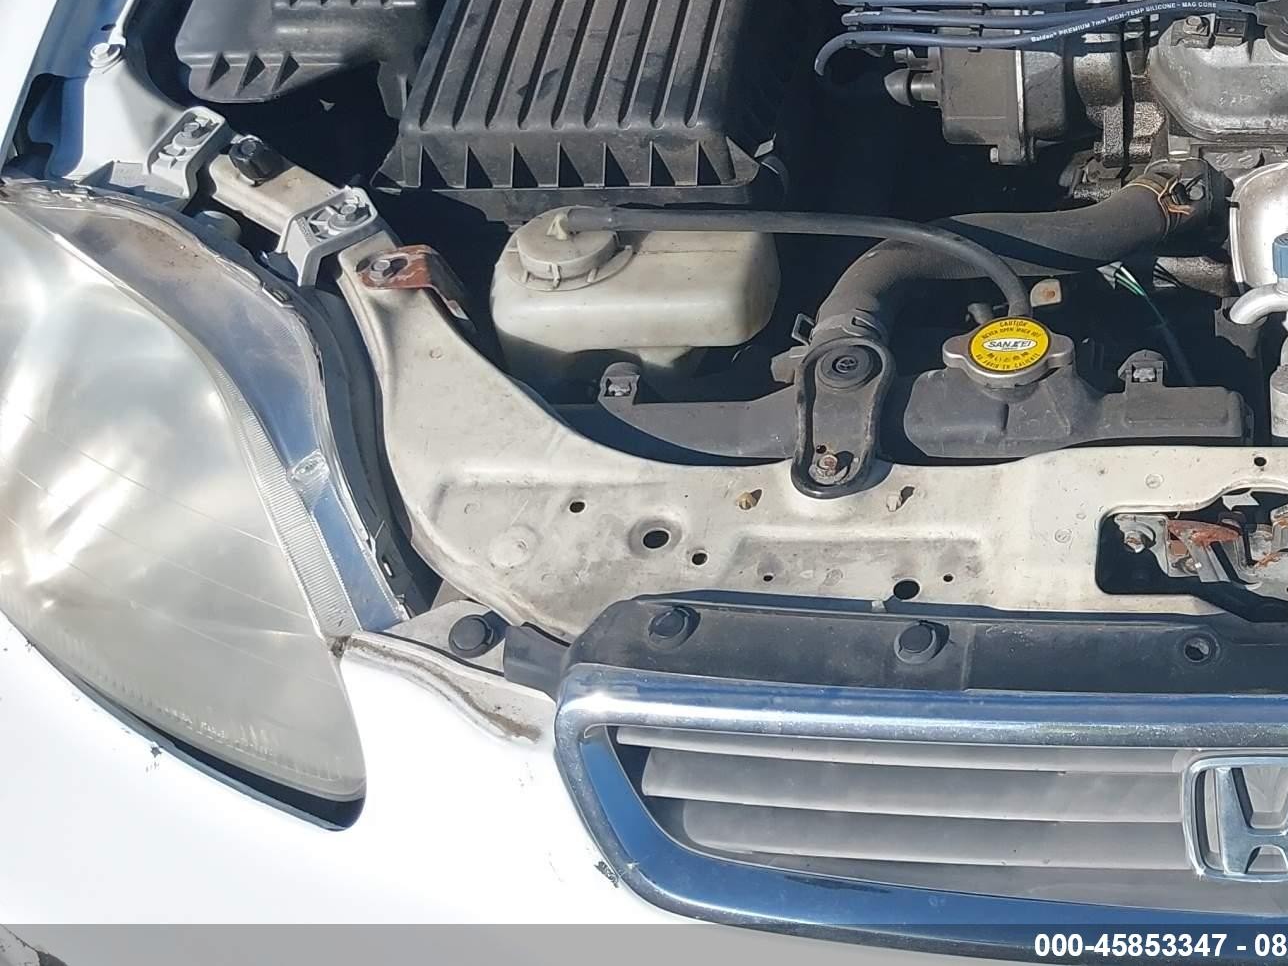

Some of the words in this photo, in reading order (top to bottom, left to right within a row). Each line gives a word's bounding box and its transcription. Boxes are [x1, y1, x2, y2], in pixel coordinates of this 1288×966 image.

[1058, 22, 1091, 37] PREMIUM
[1091, 18, 1107, 27] 7mm
[1107, 7, 1145, 23] HIGH-TEMP
[1145, 2, 1177, 12] SILICONE
[999, 320, 1029, 328] CAUTION
[981, 329, 999, 339] NEVER
